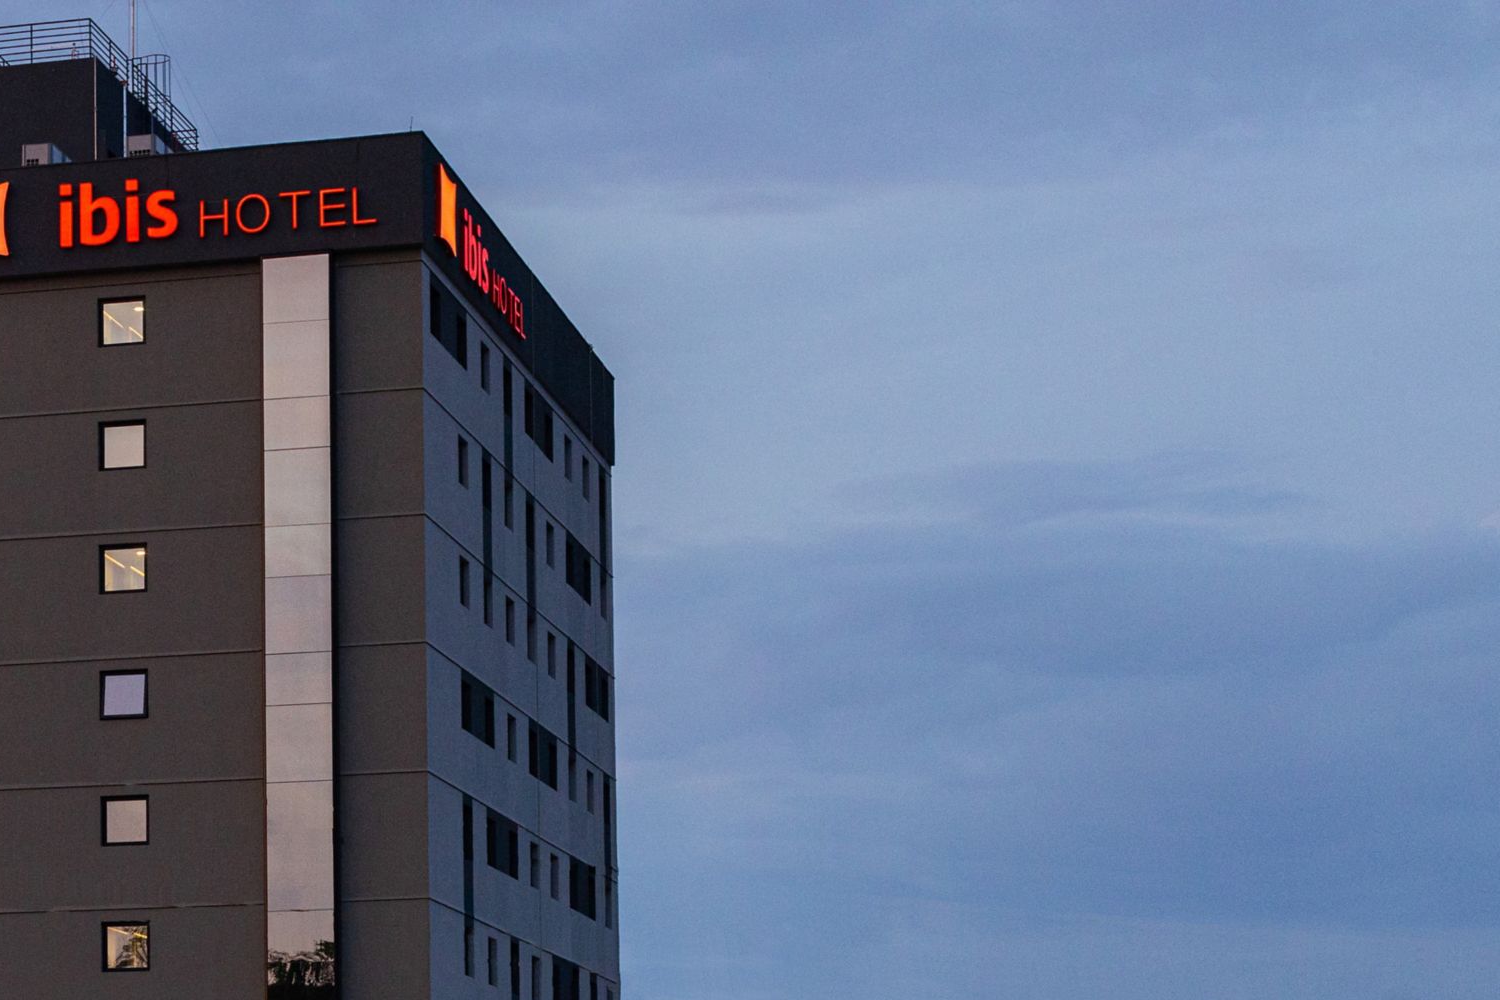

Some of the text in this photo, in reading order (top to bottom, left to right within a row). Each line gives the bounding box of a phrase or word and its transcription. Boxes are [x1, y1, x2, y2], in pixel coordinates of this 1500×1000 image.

[58, 178, 378, 248] ibis HOTEL
[463, 207, 527, 340] ibis HOTEL
